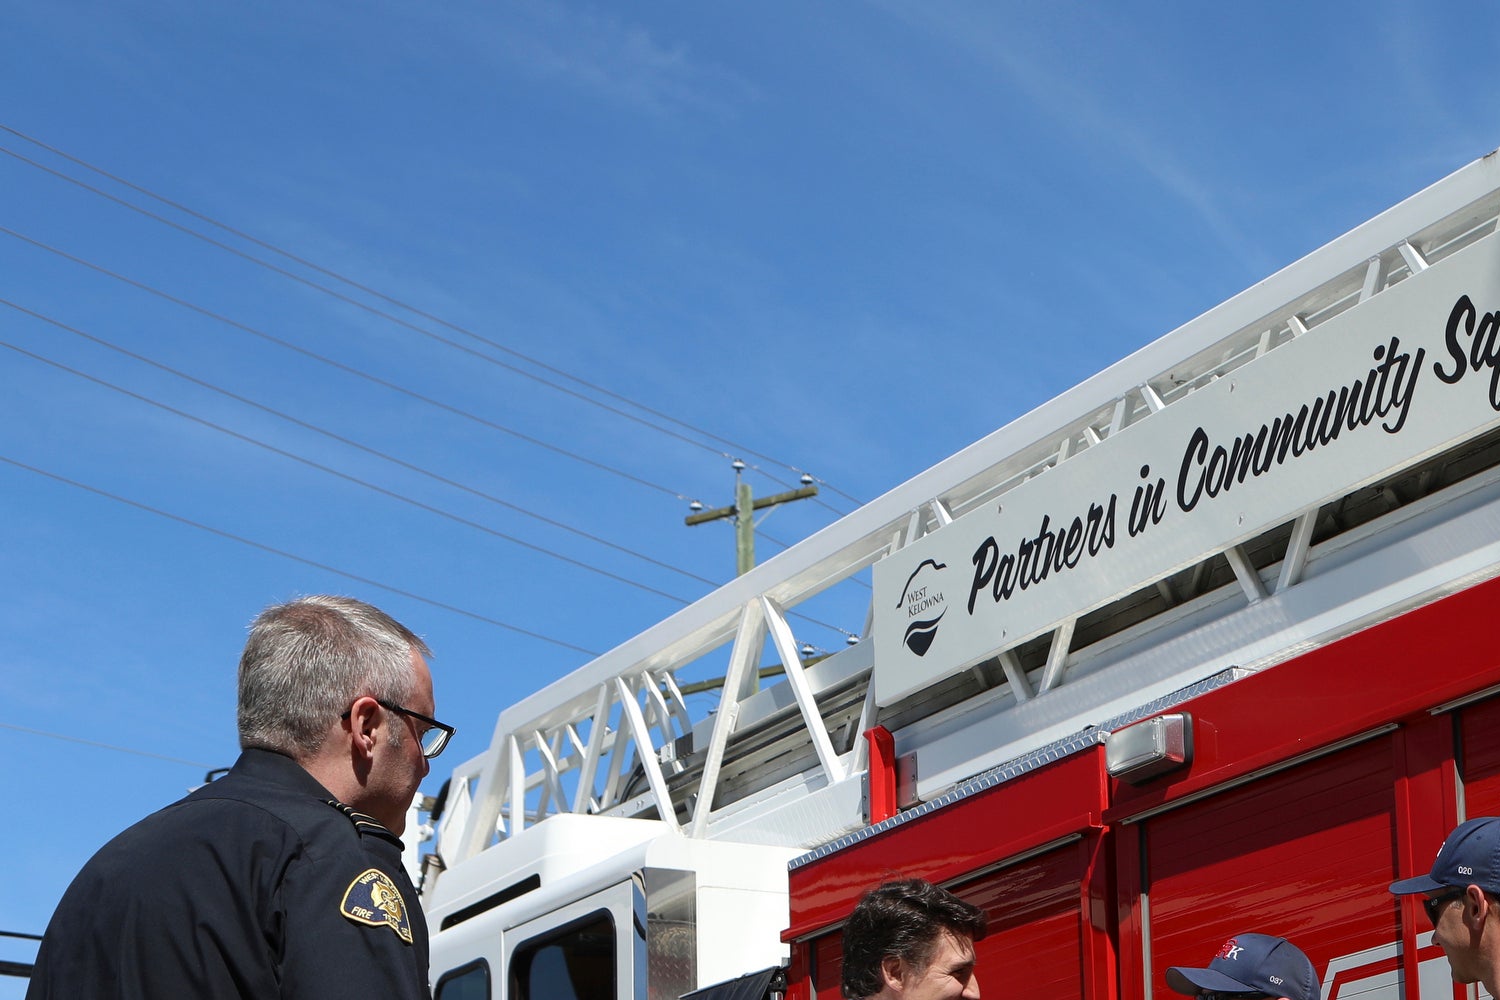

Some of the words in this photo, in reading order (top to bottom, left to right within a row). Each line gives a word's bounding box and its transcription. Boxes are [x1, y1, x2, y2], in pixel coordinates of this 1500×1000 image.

[968, 494, 1117, 615] Partners
[1129, 465, 1167, 537] in
[1177, 337, 1425, 512] Community
[907, 586, 927, 604] WEST
[908, 592, 944, 617] KELOWNA
[1458, 866, 1472, 875] 020
[351, 906, 373, 919] FIRE
[1269, 975, 1283, 986] 037
